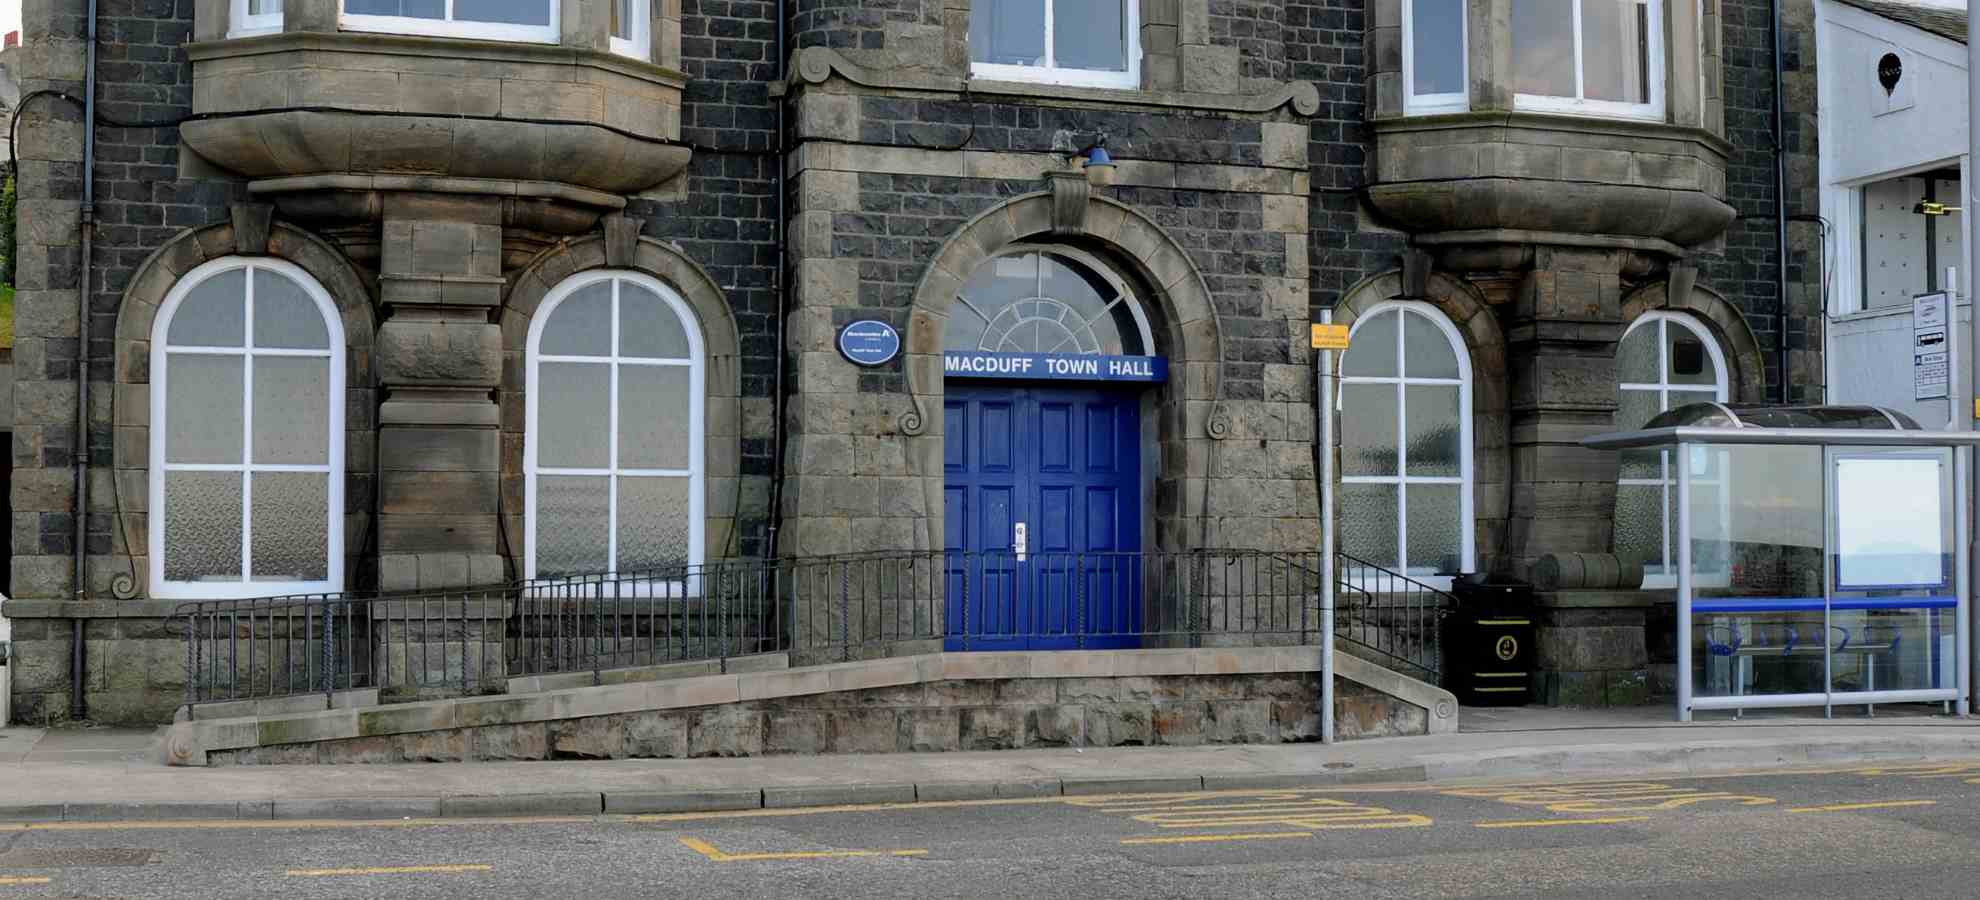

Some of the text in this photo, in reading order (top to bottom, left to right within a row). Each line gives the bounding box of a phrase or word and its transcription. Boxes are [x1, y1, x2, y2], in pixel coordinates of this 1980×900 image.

[944, 356, 1154, 376] MACDUFF TOWN HALL
[1064, 792, 1433, 829] STOP
